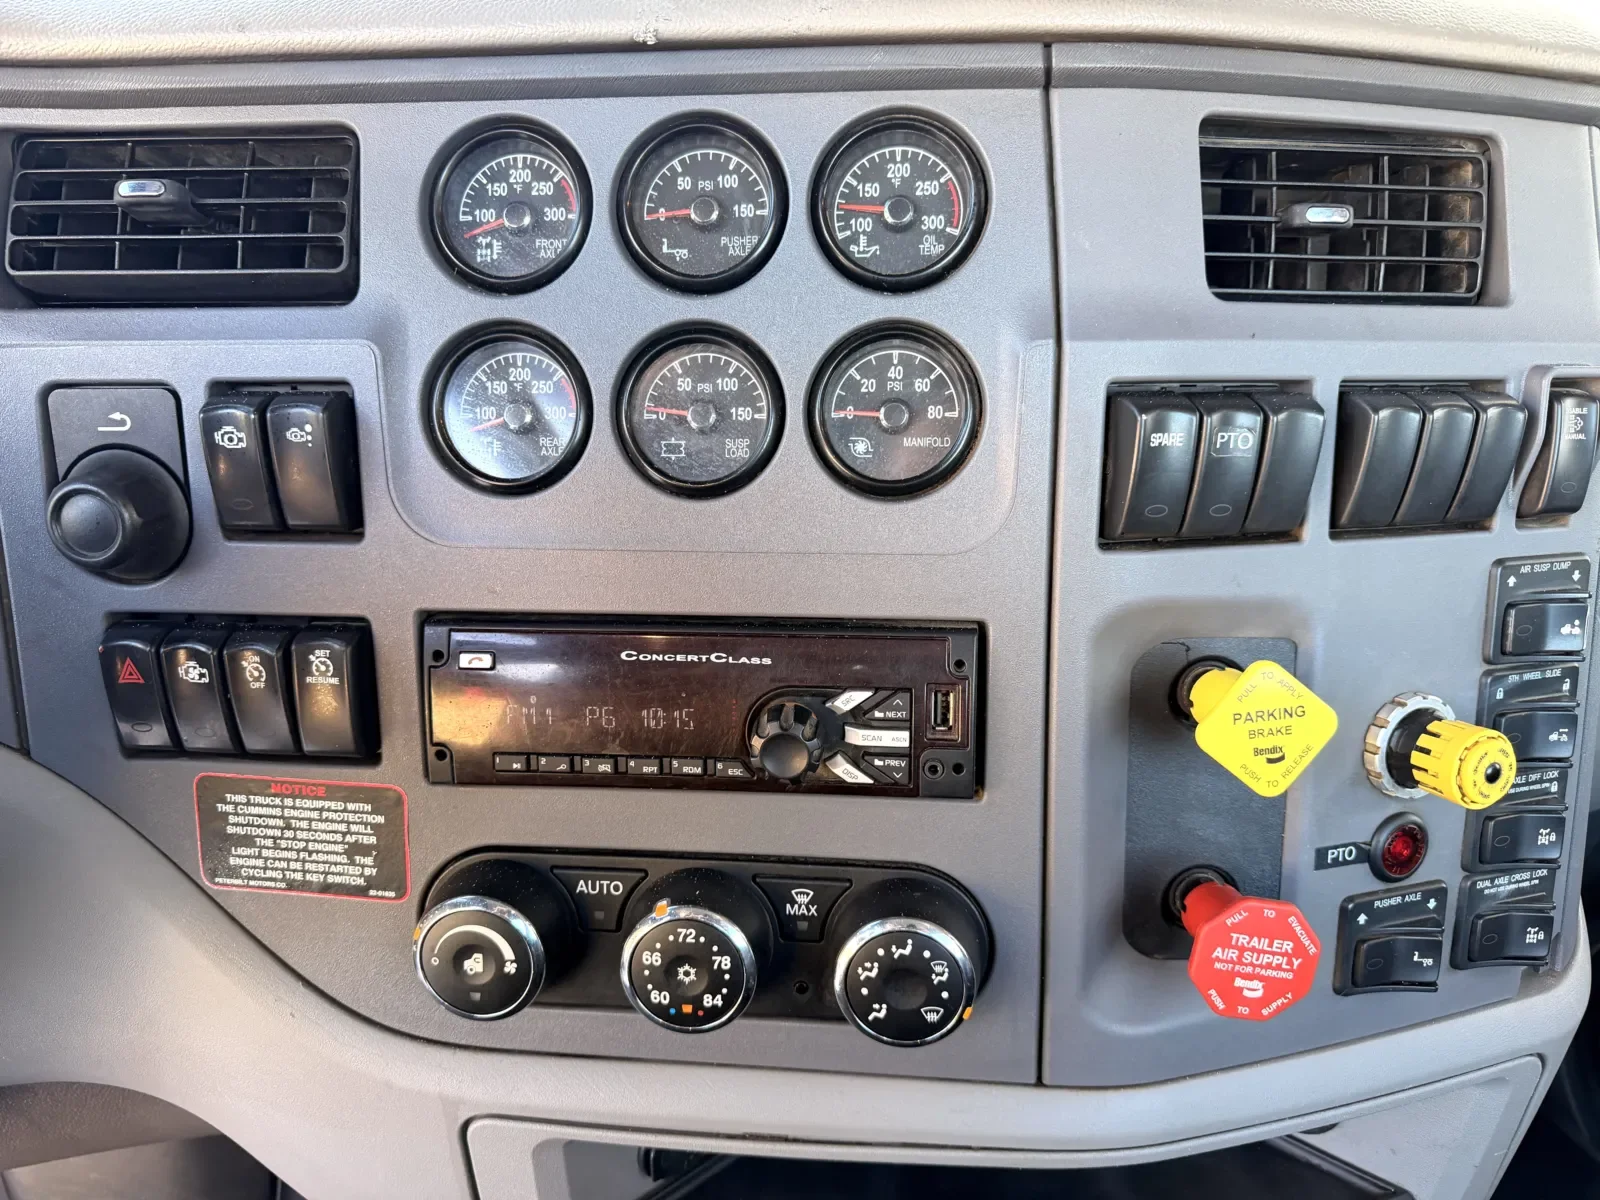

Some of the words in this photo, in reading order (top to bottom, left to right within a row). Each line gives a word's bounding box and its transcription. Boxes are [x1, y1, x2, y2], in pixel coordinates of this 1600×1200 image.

[509, 169, 531, 182] 200
[887, 163, 911, 178] 200
[531, 182, 554, 195] 250
[677, 176, 691, 190] 50
[698, 181, 714, 191] PSI
[717, 175, 738, 189] 100
[915, 181, 939, 195] 250
[486, 183, 508, 196] 150
[857, 183, 880, 197] 150
[474, 209, 496, 222] 100
[544, 208, 566, 221] 300
[733, 204, 754, 217] 150
[850, 218, 873, 232] 100
[921, 216, 945, 230] 300
[535, 239, 567, 249] FRONT
[720, 236, 759, 247] PUSHER
[923, 235, 938, 245] OIL
[919, 245, 945, 255] TEMP
[509, 368, 531, 381] 200
[888, 366, 903, 379] 40
[486, 381, 508, 394] 150
[531, 381, 554, 394] 250
[677, 378, 692, 391] 50
[697, 384, 713, 393] PSI
[716, 378, 738, 391] 100
[860, 379, 876, 392] 20
[887, 382, 903, 391] PSI
[915, 379, 930, 392] 60
[475, 407, 496, 419] 100
[544, 407, 566, 420] 300
[730, 407, 752, 420] 150
[927, 405, 943, 419] 80
[540, 438, 565, 447] REAR
[725, 439, 750, 448] SUSP
[903, 437, 951, 447] MANIFOLD
[1150, 432, 1184, 447] SPARE
[1216, 432, 1253, 449] PTO
[725, 448, 750, 458] LOAD
[1520, 565, 1531, 574] AIR
[1534, 563, 1550, 572] SUSP
[1552, 561, 1571, 570] DUMP
[306, 676, 340, 684] RESUME
[1508, 675, 1520, 683] 5TH
[1522, 672, 1542, 680] WHEEL
[1545, 668, 1562, 678] SLIDE
[1237, 683, 1258, 703] PULL
[1261, 672, 1274, 680] TO
[1277, 679, 1304, 700] APPLY
[840, 695, 856, 707] SRC
[586, 706, 616, 728] P6
[1233, 705, 1306, 725] PARKING
[861, 734, 882, 742] SCAN
[1248, 725, 1293, 740] BRAKE
[1253, 745, 1284, 757] Bendix
[541, 757, 547, 765] 2
[673, 760, 679, 768] 5
[683, 766, 702, 774] RDM
[884, 759, 906, 767] PREV
[1239, 763, 1262, 783] PUSH
[1266, 780, 1279, 788] TO
[1281, 743, 1313, 780] RELEASE
[728, 768, 744, 776] ESC
[842, 767, 859, 781] DISP
[1528, 773, 1542, 782] DIFF
[1543, 770, 1560, 780] LOCK
[271, 783, 326, 797] NOTICE
[225, 794, 247, 803] THIS
[248, 796, 282, 806] TRUCK
[284, 798, 294, 806] IS
[296, 798, 344, 810] EQUIPPED
[346, 802, 372, 812] WITH
[216, 804, 236, 812] THE
[238, 805, 282, 816] CUMMINS
[284, 808, 320, 818] ENGINE
[322, 811, 384, 824] PROTECTION
[228, 815, 286, 827] SHUTDOWN.
[290, 819, 310, 828] THE
[312, 820, 348, 832] ENGINE
[350, 824, 374, 833] WILL
[226, 826, 282, 837] SHUTDOWN
[283, 830, 294, 839] 30
[296, 830, 343, 842] SECONDS
[344, 834, 376, 844] AFTER
[255, 838, 274, 846] THE
[276, 840, 306, 849] "STOP
[308, 842, 348, 852] ENGINE"
[232, 846, 260, 856] LIGHT
[262, 848, 298, 859] BEGINS
[299, 852, 350, 863] FLASHING.
[354, 856, 374, 865] THE
[1327, 846, 1356, 864] PTO
[230, 856, 265, 866] ENGINE
[267, 860, 288, 868] CAN
[290, 862, 303, 870] BE
[304, 862, 362, 875] RESTARTED
[364, 867, 378, 876] BY
[241, 868, 282, 878] CYCLING
[284, 871, 304, 880] THE
[306, 873, 326, 882] KEY
[327, 874, 367, 886] SWITCH.
[1476, 880, 1492, 888] DUAL
[1494, 876, 1509, 885] AXLE
[1511, 872, 1530, 882] CROSS
[1532, 868, 1548, 878] LOCK
[576, 880, 624, 896] AUTO
[1374, 896, 1402, 908] PUSHER
[1404, 892, 1422, 902] AXLE
[786, 903, 818, 916] MAX
[677, 928, 696, 943] 72
[1226, 910, 1248, 926] PULL
[1263, 909, 1276, 918] TO
[1288, 916, 1318, 956] EVACUATE
[1230, 932, 1294, 954] TRAILER
[642, 951, 662, 966] 66
[712, 956, 731, 970] 78
[1212, 946, 1239, 962] AIR
[1242, 951, 1302, 970] SUPPLY
[1214, 962, 1234, 970] NOT
[1234, 965, 1254, 974] FOR
[1254, 968, 1294, 980] PARKING
[1234, 977, 1264, 989] Bendix
[650, 990, 670, 1005] 60
[703, 994, 723, 1007] 84
[1208, 988, 1226, 1010] PUSH
[1237, 1006, 1250, 1014] TO
[1261, 992, 1293, 1016] SUPPLY
